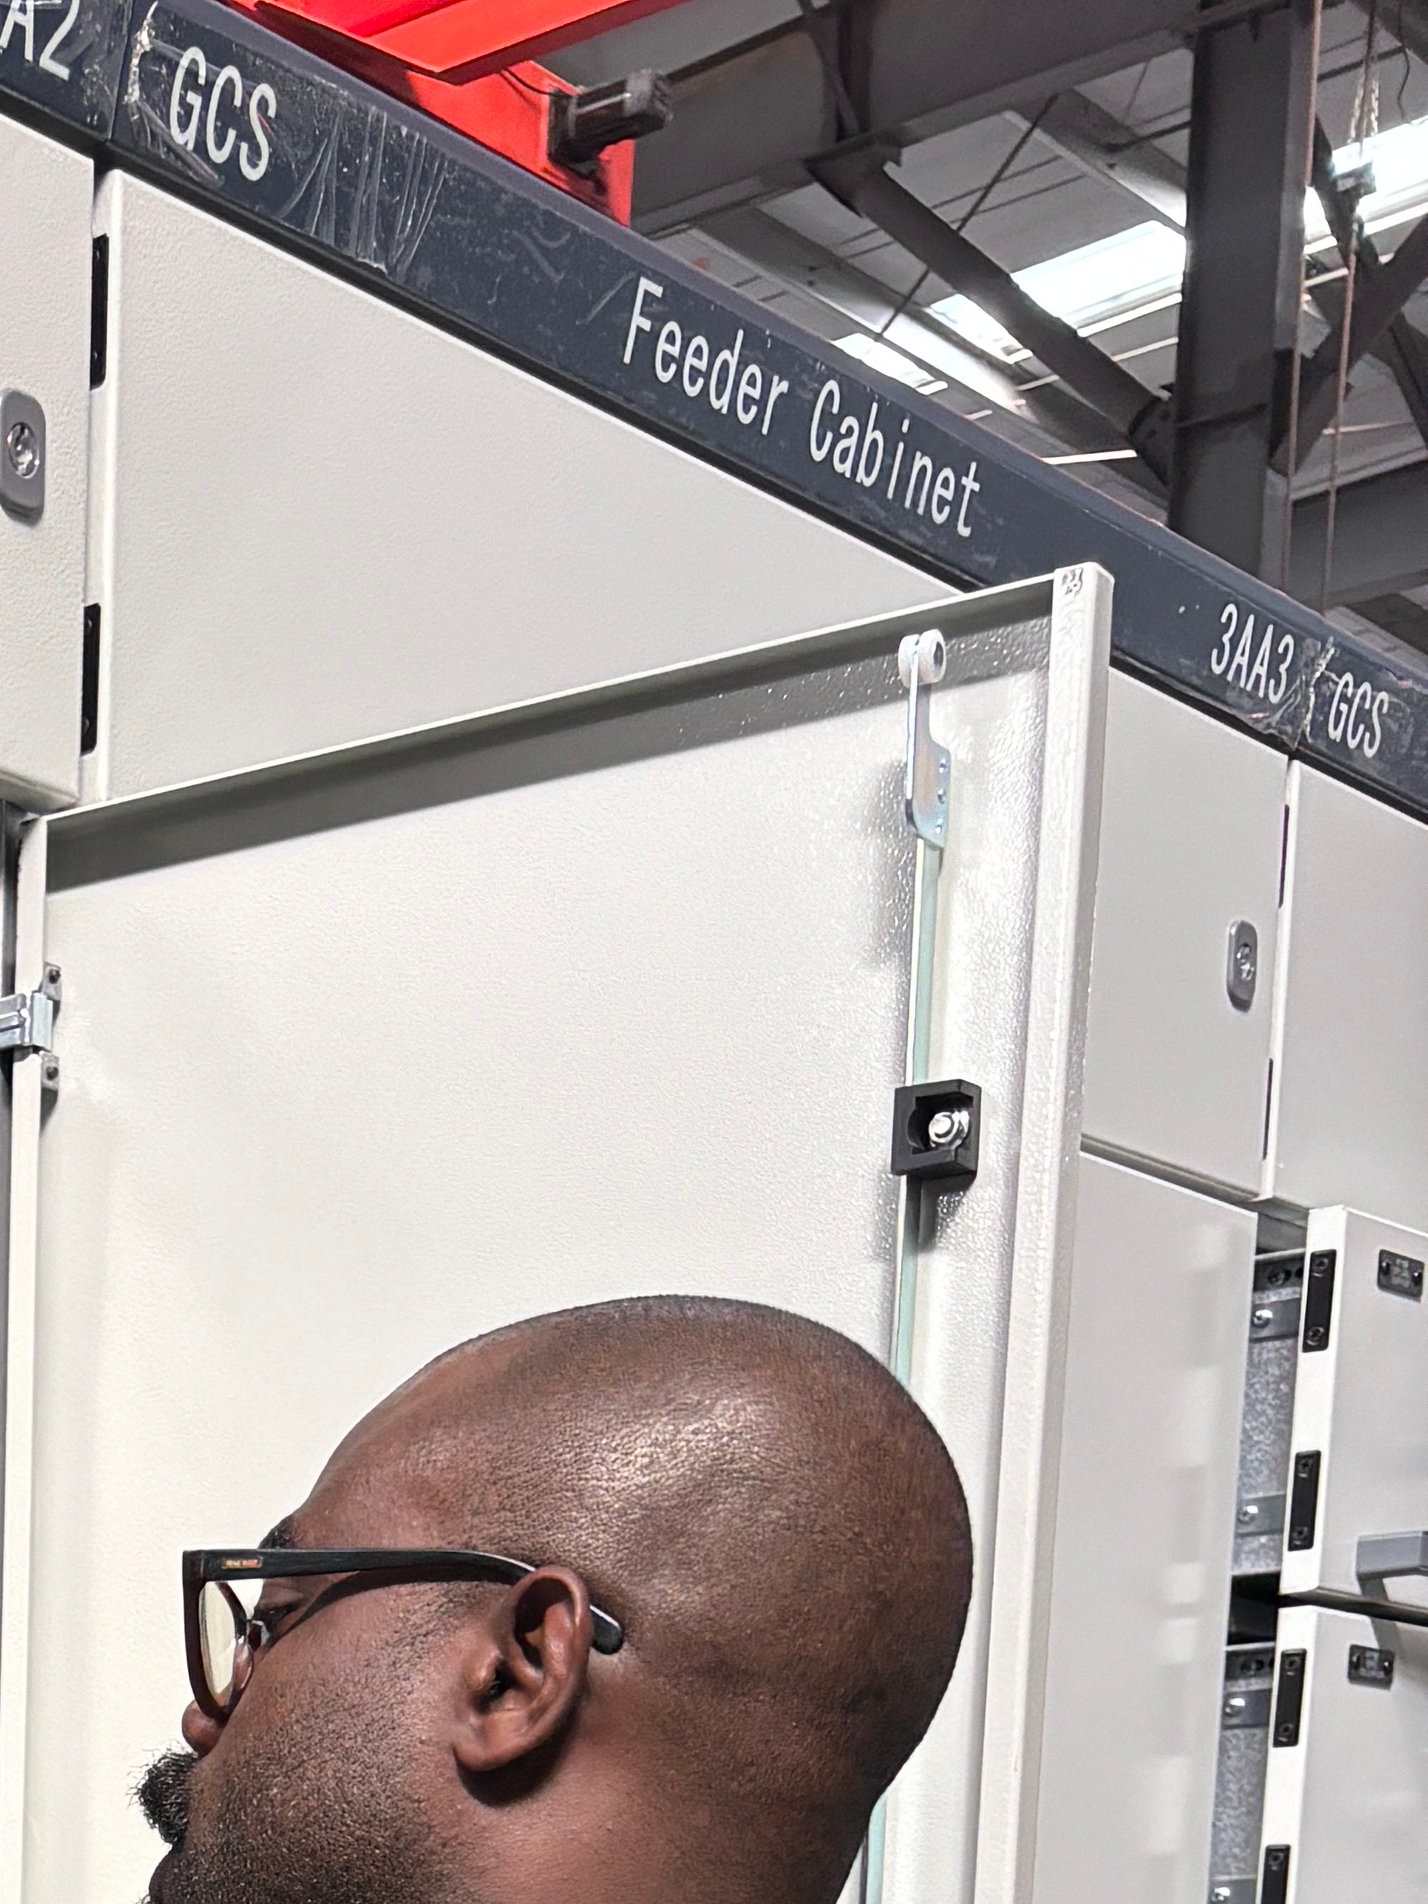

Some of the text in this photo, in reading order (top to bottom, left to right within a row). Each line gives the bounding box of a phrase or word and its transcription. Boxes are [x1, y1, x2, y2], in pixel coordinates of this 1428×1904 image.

[169, 46, 277, 182] GCS
[623, 276, 980, 538] Feeder Cabinet
[1211, 603, 1295, 705] 3AA3
[1328, 672, 1389, 758] GCS
